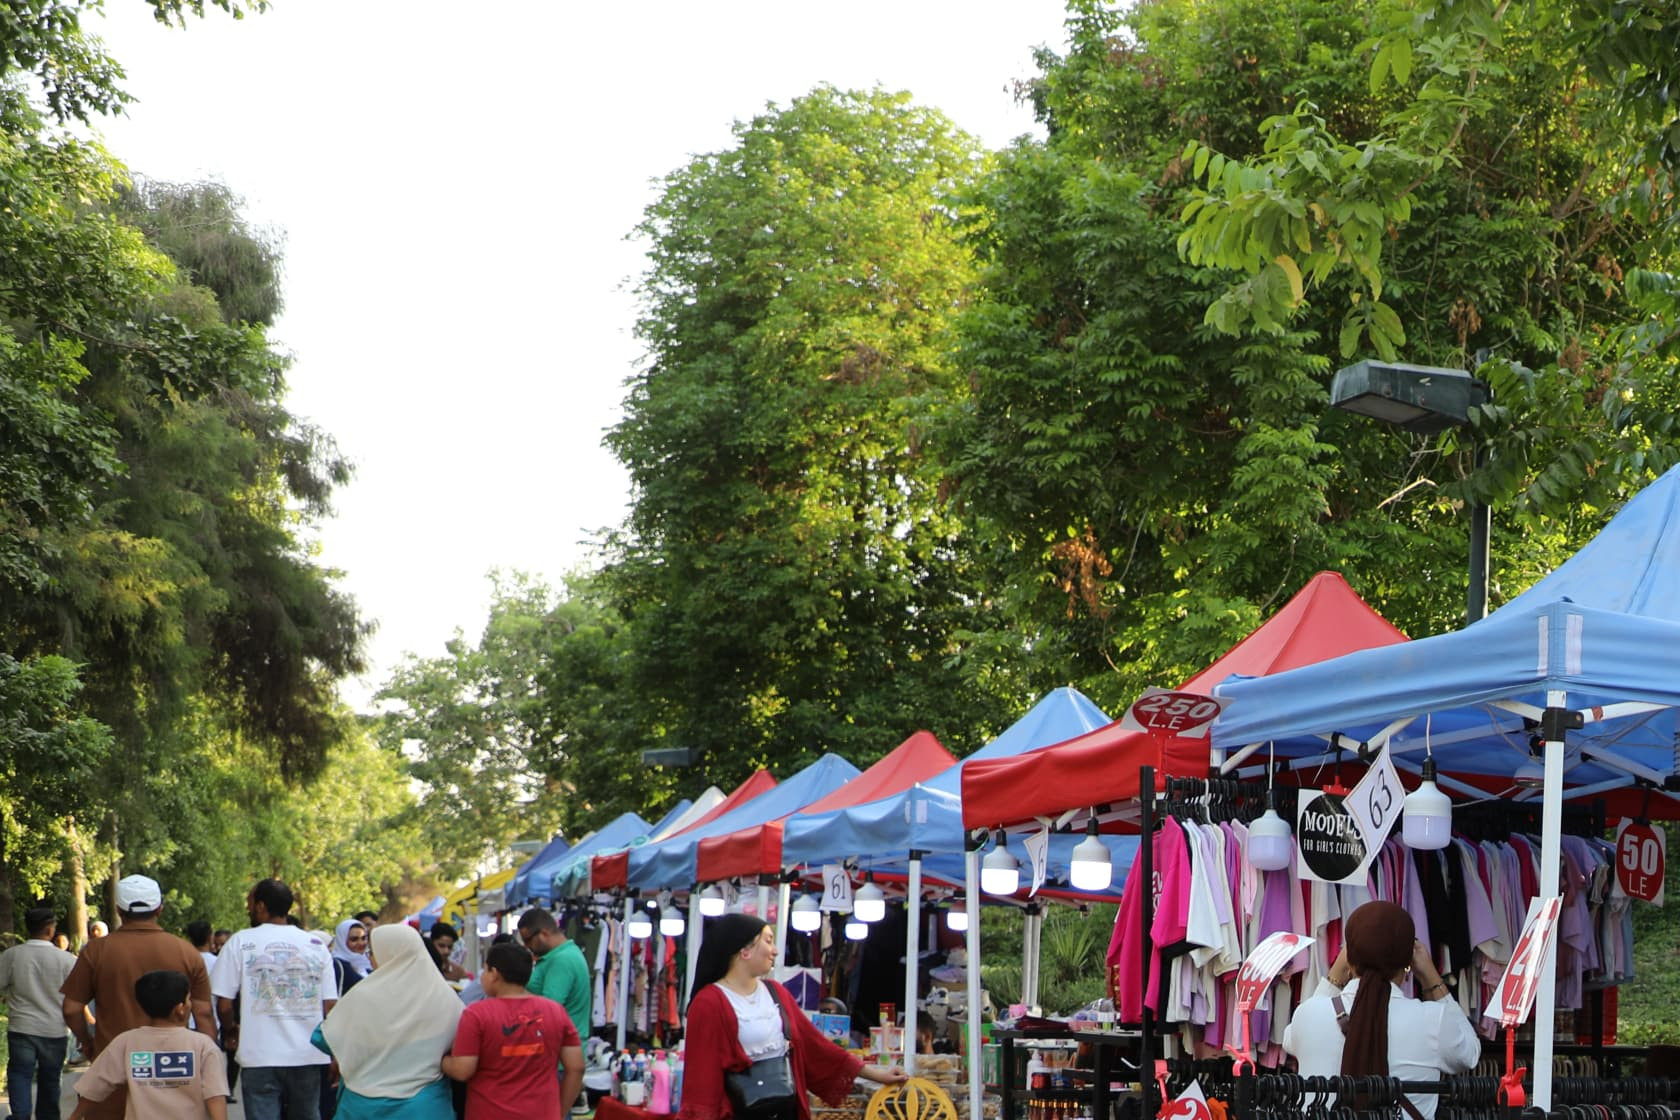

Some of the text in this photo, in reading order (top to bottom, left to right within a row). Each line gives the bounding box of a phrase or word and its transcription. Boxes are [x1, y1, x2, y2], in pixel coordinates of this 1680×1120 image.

[1138, 694, 1218, 718] 250
[1147, 712, 1186, 730] L.E
[1368, 768, 1393, 830] 63
[1303, 838, 1314, 851] FOR
[1335, 842, 1362, 856] CLOTHES
[1622, 833, 1659, 876] 50
[831, 874, 847, 900] 61
[1628, 871, 1648, 897] L.E
